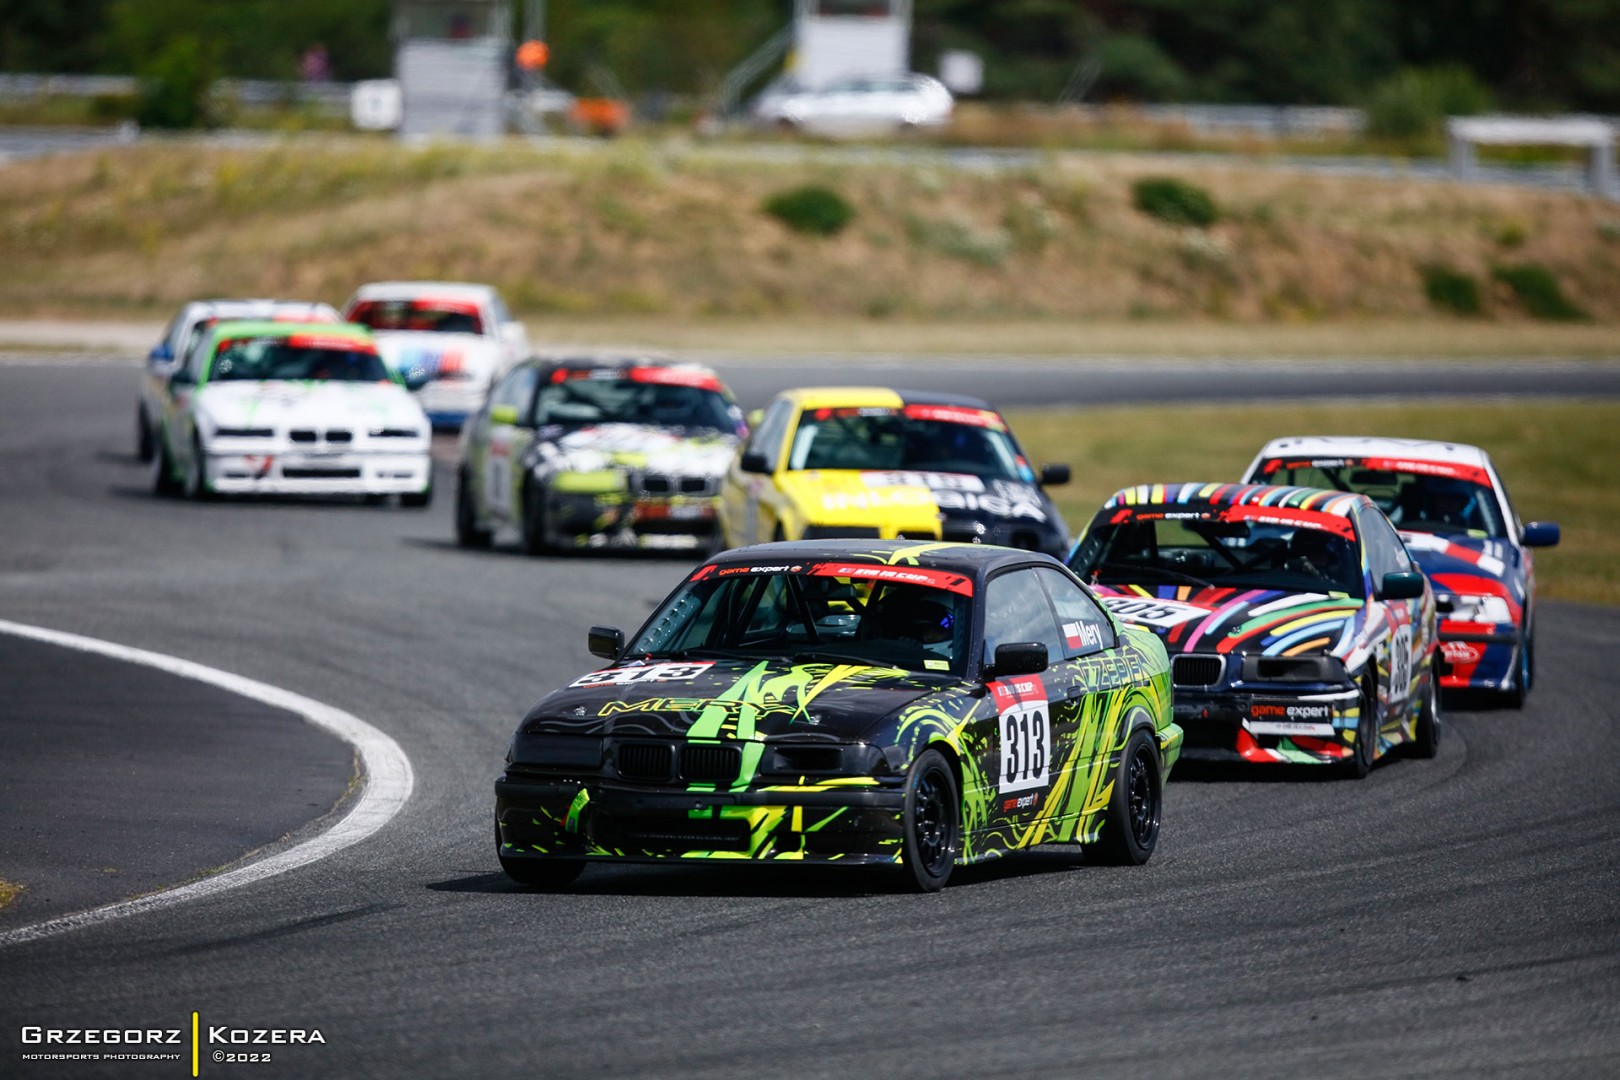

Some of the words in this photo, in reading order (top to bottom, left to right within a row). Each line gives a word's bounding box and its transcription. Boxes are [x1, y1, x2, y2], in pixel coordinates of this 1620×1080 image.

[1165, 510, 1200, 520] expert
[718, 566, 750, 577] game
[750, 565, 790, 574] expert
[1075, 620, 1104, 650] Mery
[579, 666, 701, 684] 313
[598, 697, 797, 718] MERY
[1250, 705, 1286, 718] game
[1286, 705, 1329, 719] expert
[1006, 710, 1045, 784] 313
